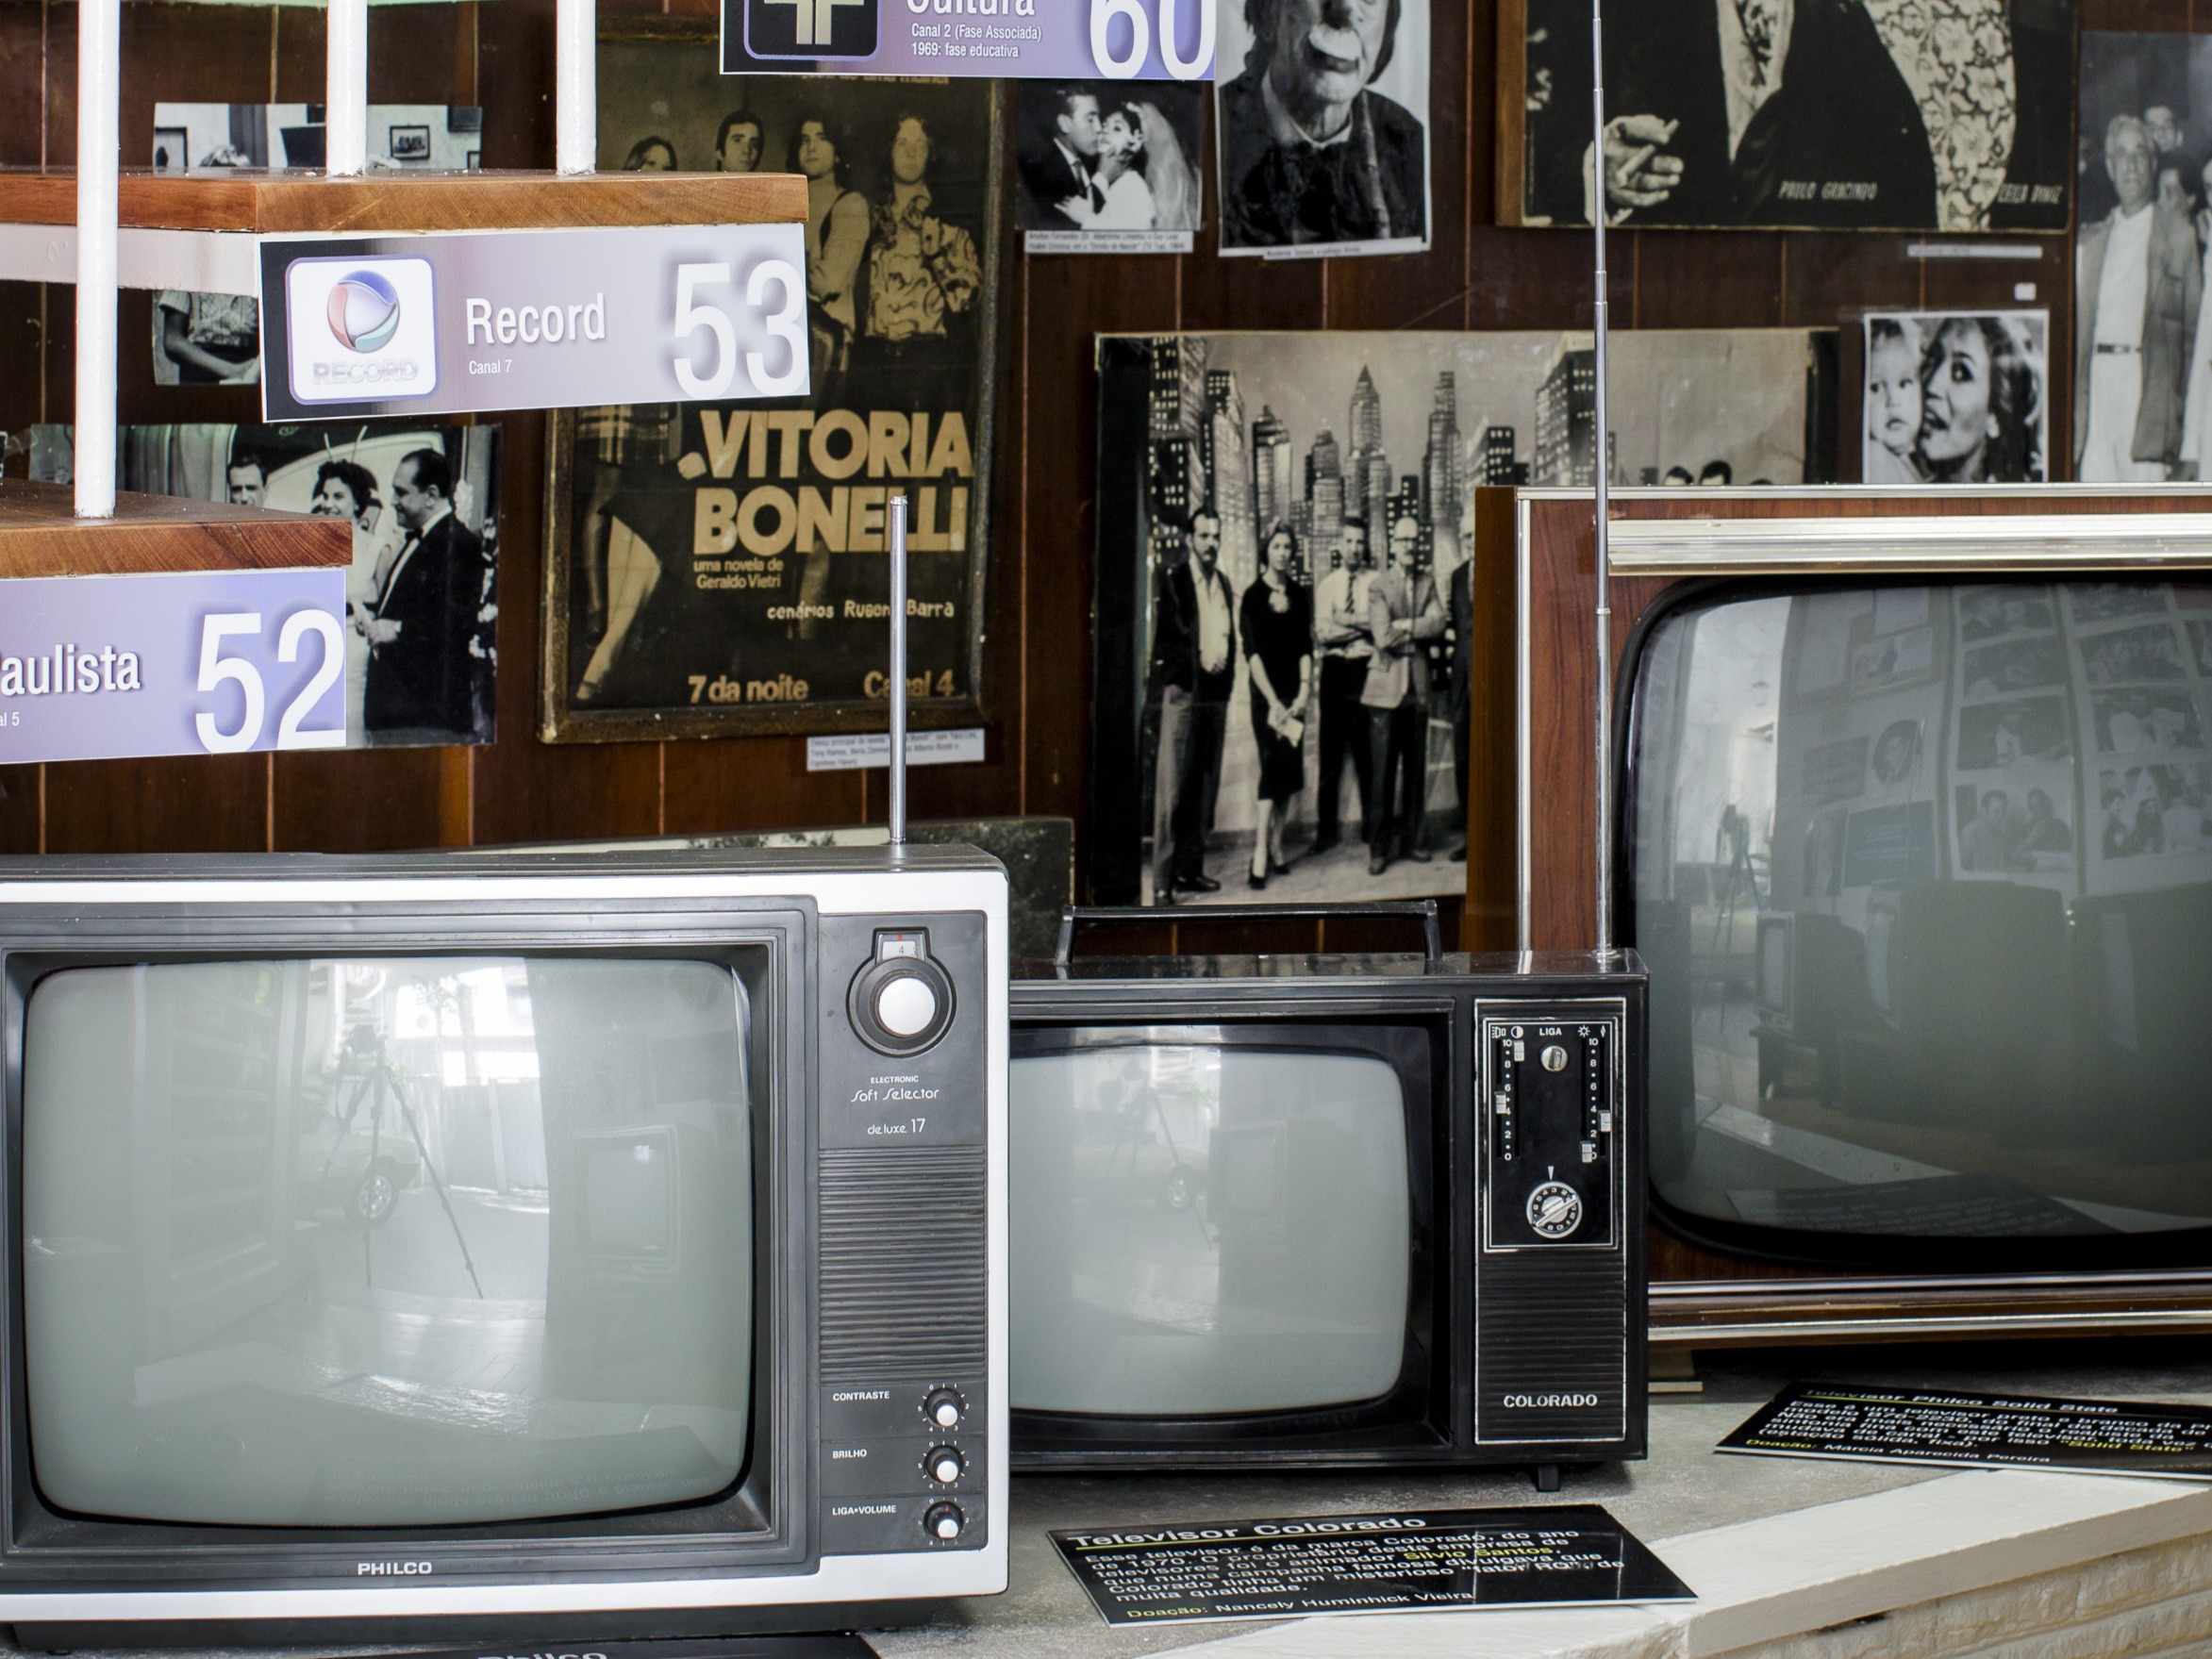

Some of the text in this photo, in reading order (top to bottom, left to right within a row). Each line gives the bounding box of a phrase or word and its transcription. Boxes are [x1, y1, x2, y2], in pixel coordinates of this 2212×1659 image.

[911, 23, 1041, 42] Canal 2 (Fase Associada)
[1089, 0, 1216, 80] 60
[911, 41, 1019, 58] 1969: fase educativa
[465, 292, 607, 345] Record
[673, 258, 808, 399] 53
[312, 358, 419, 386] RECORD
[468, 358, 512, 374] Canal 7
[699, 409, 974, 479] VITORIA
[693, 486, 969, 556] BONELLI
[693, 558, 784, 572] uma novela de
[696, 572, 781, 589] Geraldo Vietri
[767, 600, 835, 620] cenários
[906, 598, 955, 618] Barra
[0, 643, 141, 696] aulista
[195, 608, 346, 754] 52
[688, 675, 707, 704] 7
[708, 675, 741, 703] da
[746, 673, 809, 702] noite
[936, 670, 956, 698] 4
[11, 711, 20, 726] 5
[871, 1075, 919, 1084] ELECTRONIC
[851, 1087, 940, 1103] Soft Selector
[910, 1119, 926, 1133] 17
[1505, 1130, 1511, 1138] 2
[833, 1391, 890, 1402] CONTRASTE
[1503, 1394, 1598, 1408] COLORADO
[1912, 1395, 1983, 1405] Philco
[832, 1449, 867, 1459] BRILHO
[1067, 1518, 1426, 1547] Televisor Colorado
[1085, 1553, 1138, 1563] Esse
[1145, 1547, 1240, 1559] televisor
[1251, 1545, 1263, 1554] é
[1272, 1543, 1300, 1551] da
[1307, 1539, 1377, 1550] marca
[1502, 1532, 1530, 1540] do
[1128, 1557, 1192, 1568] 1970.
[1201, 1555, 1219, 1564] O
[1227, 1549, 1359, 1563] proprietário
[1368, 1544, 1430, 1554] desta
[1437, 1540, 1535, 1551] empresa
[357, 1561, 433, 1577] PHILCO
[1095, 1565, 1220, 1578] televisores
[1226, 1562, 1257, 1570] foi
[1289, 1554, 1394, 1567] animador
[1404, 1550, 1467, 1560] Silvio
[1104, 1552, 1603, 1586] que numa campanha famosa divulgava que
[1108, 1581, 1213, 1594] Colorado
[1221, 1576, 1280, 1587] tinha
[1334, 1568, 1455, 1580] misterioso
[1597, 1560, 1625, 1568] de
[1116, 1584, 1307, 1601] muita qualidade.
[1126, 1605, 1208, 1618] Doação:
[1215, 1601, 1293, 1613] Nancely
[1414, 1591, 1473, 1601] Vieira
